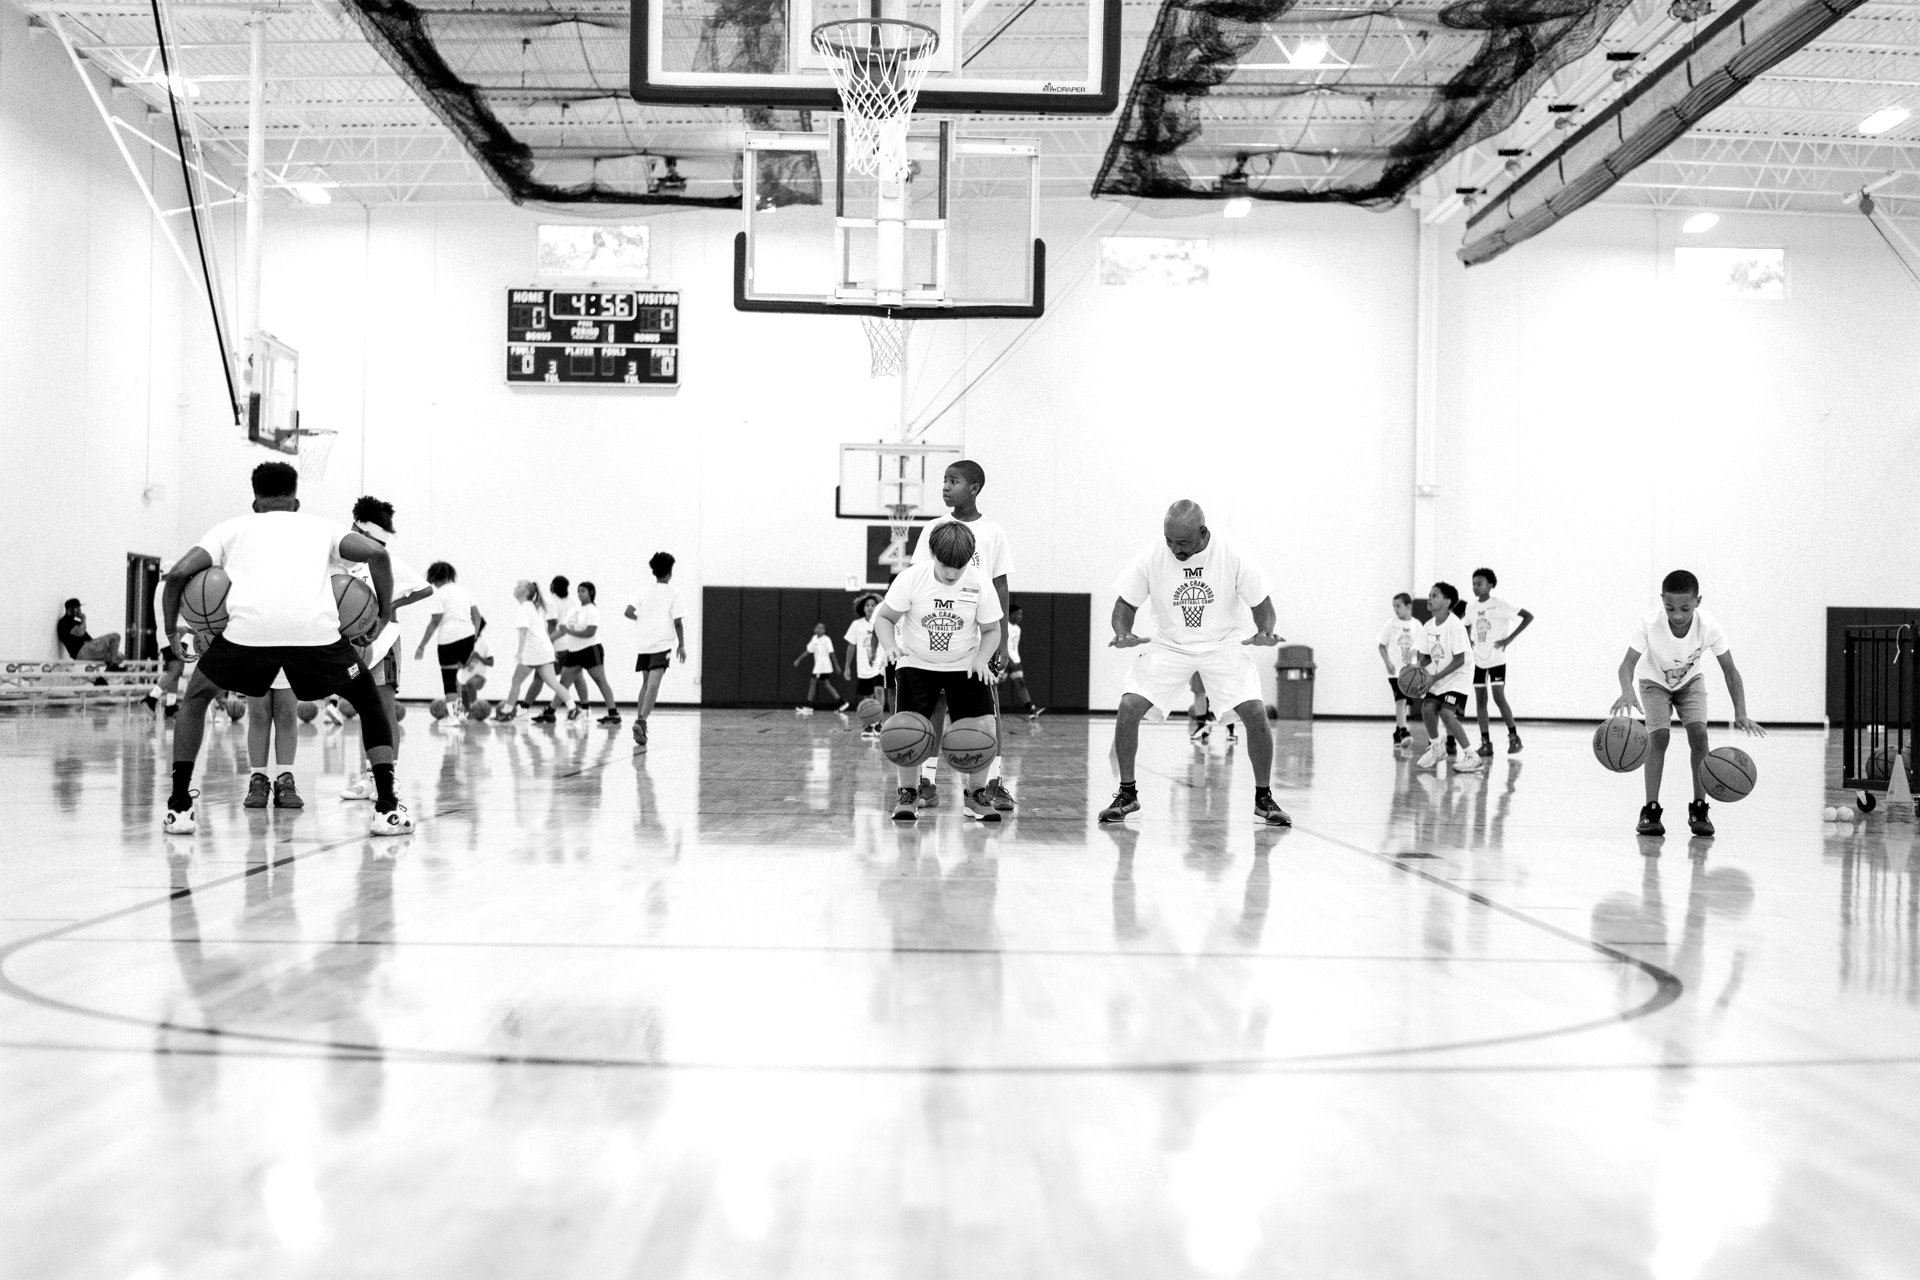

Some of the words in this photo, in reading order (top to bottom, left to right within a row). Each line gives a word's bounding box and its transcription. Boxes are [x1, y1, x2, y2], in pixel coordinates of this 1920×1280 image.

[513, 291, 545, 304] HOME
[638, 293, 679, 305] VISITOR
[571, 293, 629, 317] 4:56
[532, 307, 546, 329] 0
[661, 308, 674, 331] 0
[525, 332, 552, 342] BONUS
[634, 333, 660, 343] BONUS
[510, 347, 536, 355] FOULS
[565, 348, 594, 356] PLAYER
[602, 348, 626, 356] FOULS
[651, 348, 676, 356] FOULS
[549, 360, 557, 374] 3
[628, 362, 637, 375] 3
[878, 540, 914, 574] 4
[1183, 567, 1204, 577] TMT
[1190, 580, 1214, 598] CRAWFORD
[934, 599, 955, 608] TMT
